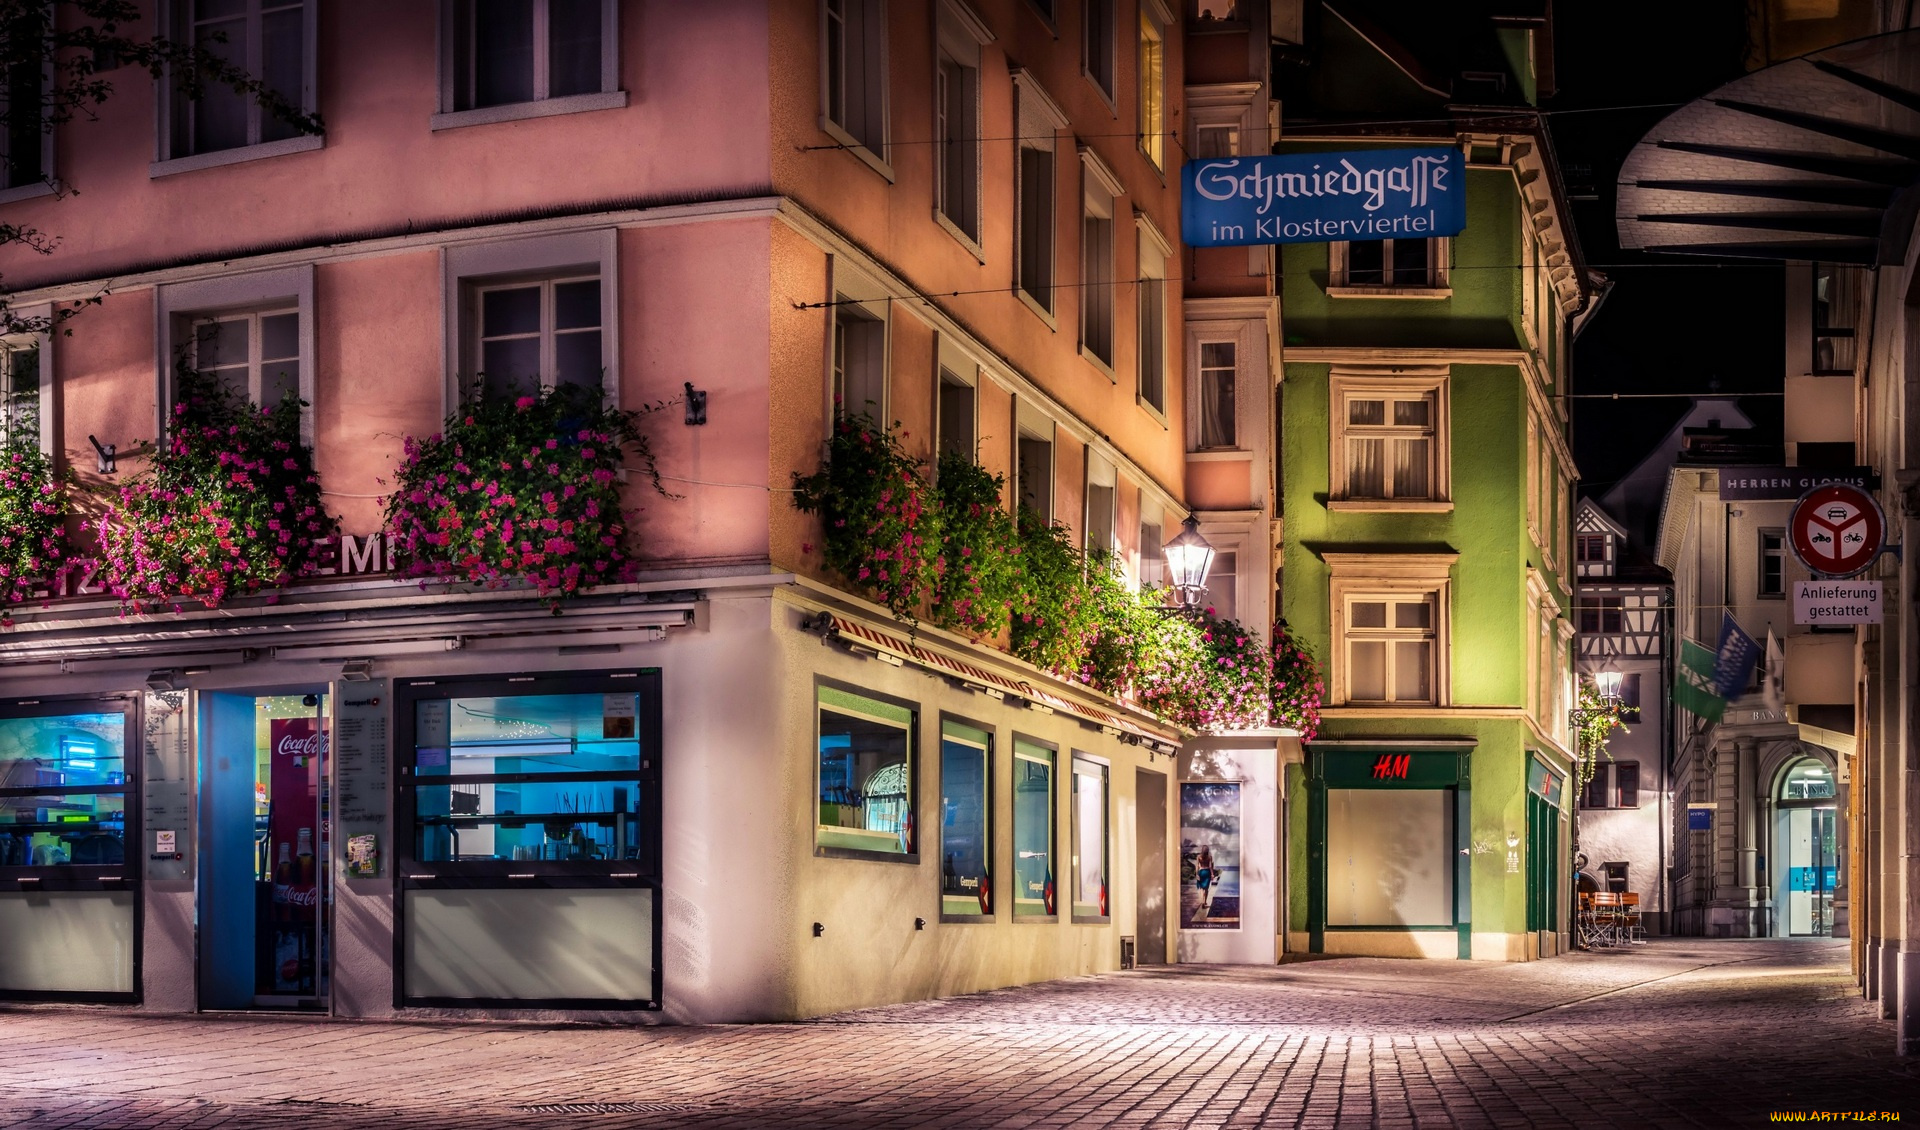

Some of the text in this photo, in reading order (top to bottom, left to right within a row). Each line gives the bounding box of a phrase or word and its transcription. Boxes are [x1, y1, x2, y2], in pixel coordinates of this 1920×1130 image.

[1212, 210, 1435, 241] im Klosterviertel
[1727, 478, 1791, 489] HERREN
[1801, 586, 1877, 602] Anlieferung
[1809, 604, 1869, 622] gestattet
[1373, 754, 1411, 779] H&M
